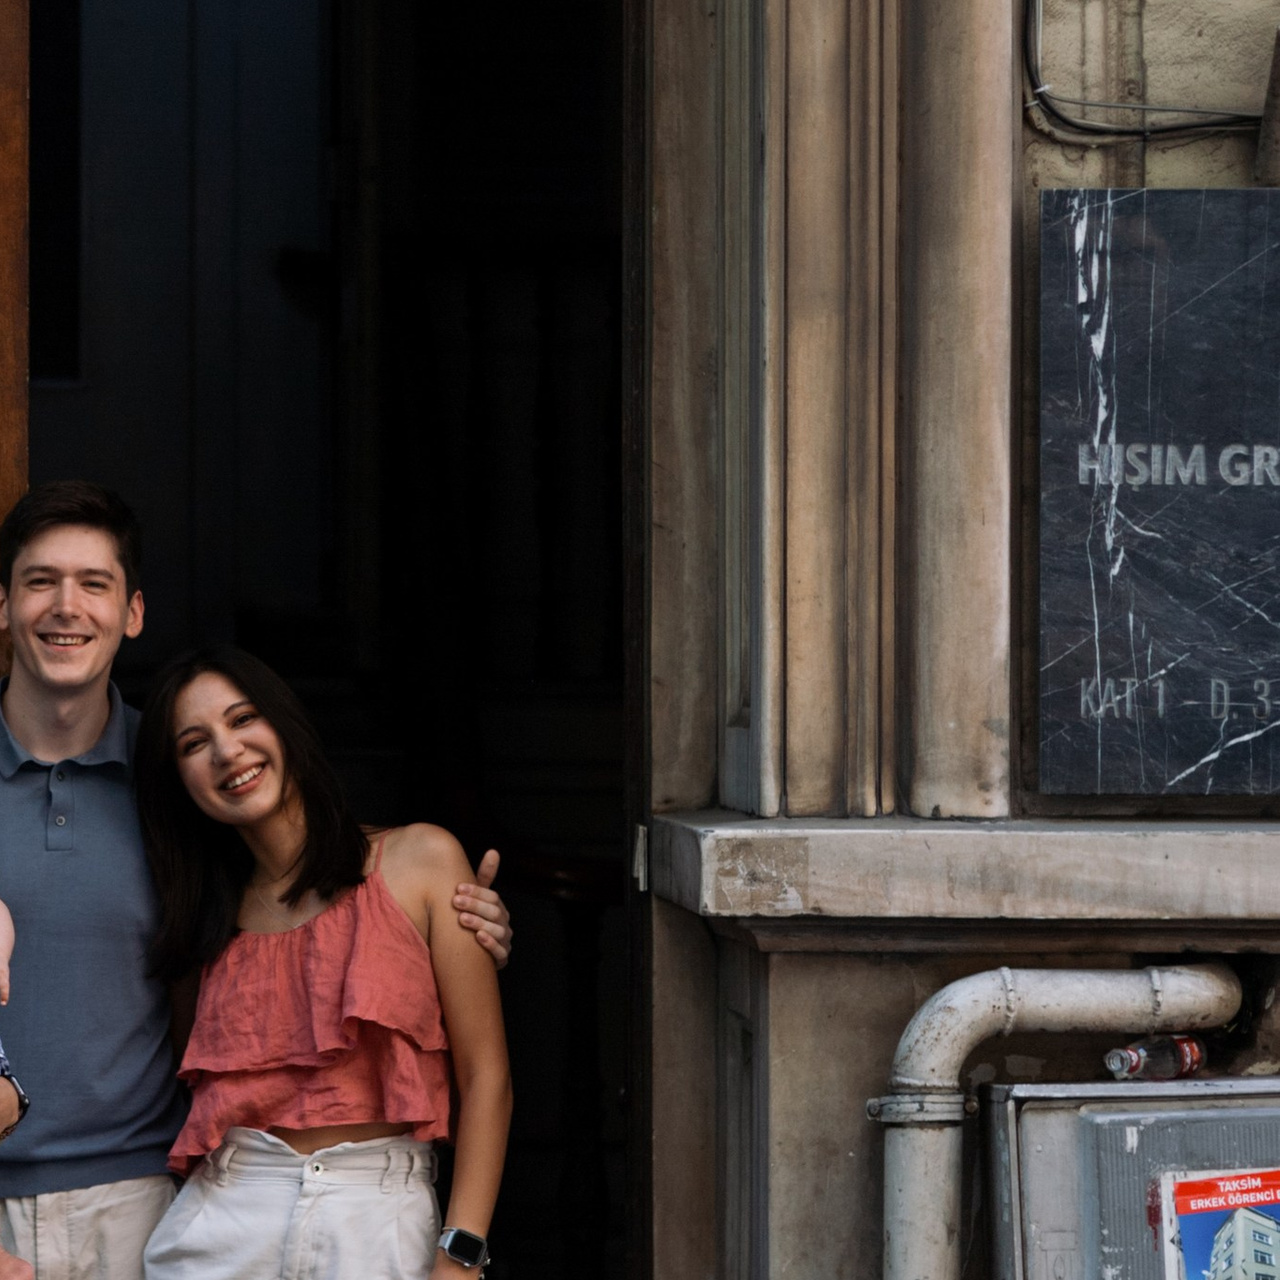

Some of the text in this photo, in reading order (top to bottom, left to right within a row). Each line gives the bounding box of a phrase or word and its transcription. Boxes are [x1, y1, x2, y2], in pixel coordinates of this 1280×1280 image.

[1080, 677, 1140, 719] KAT
[1217, 1176, 1262, 1193] TAKSİM
[1190, 1196, 1227, 1210] ERKEK
[1228, 1188, 1275, 1206] ÖĞRENCİ
